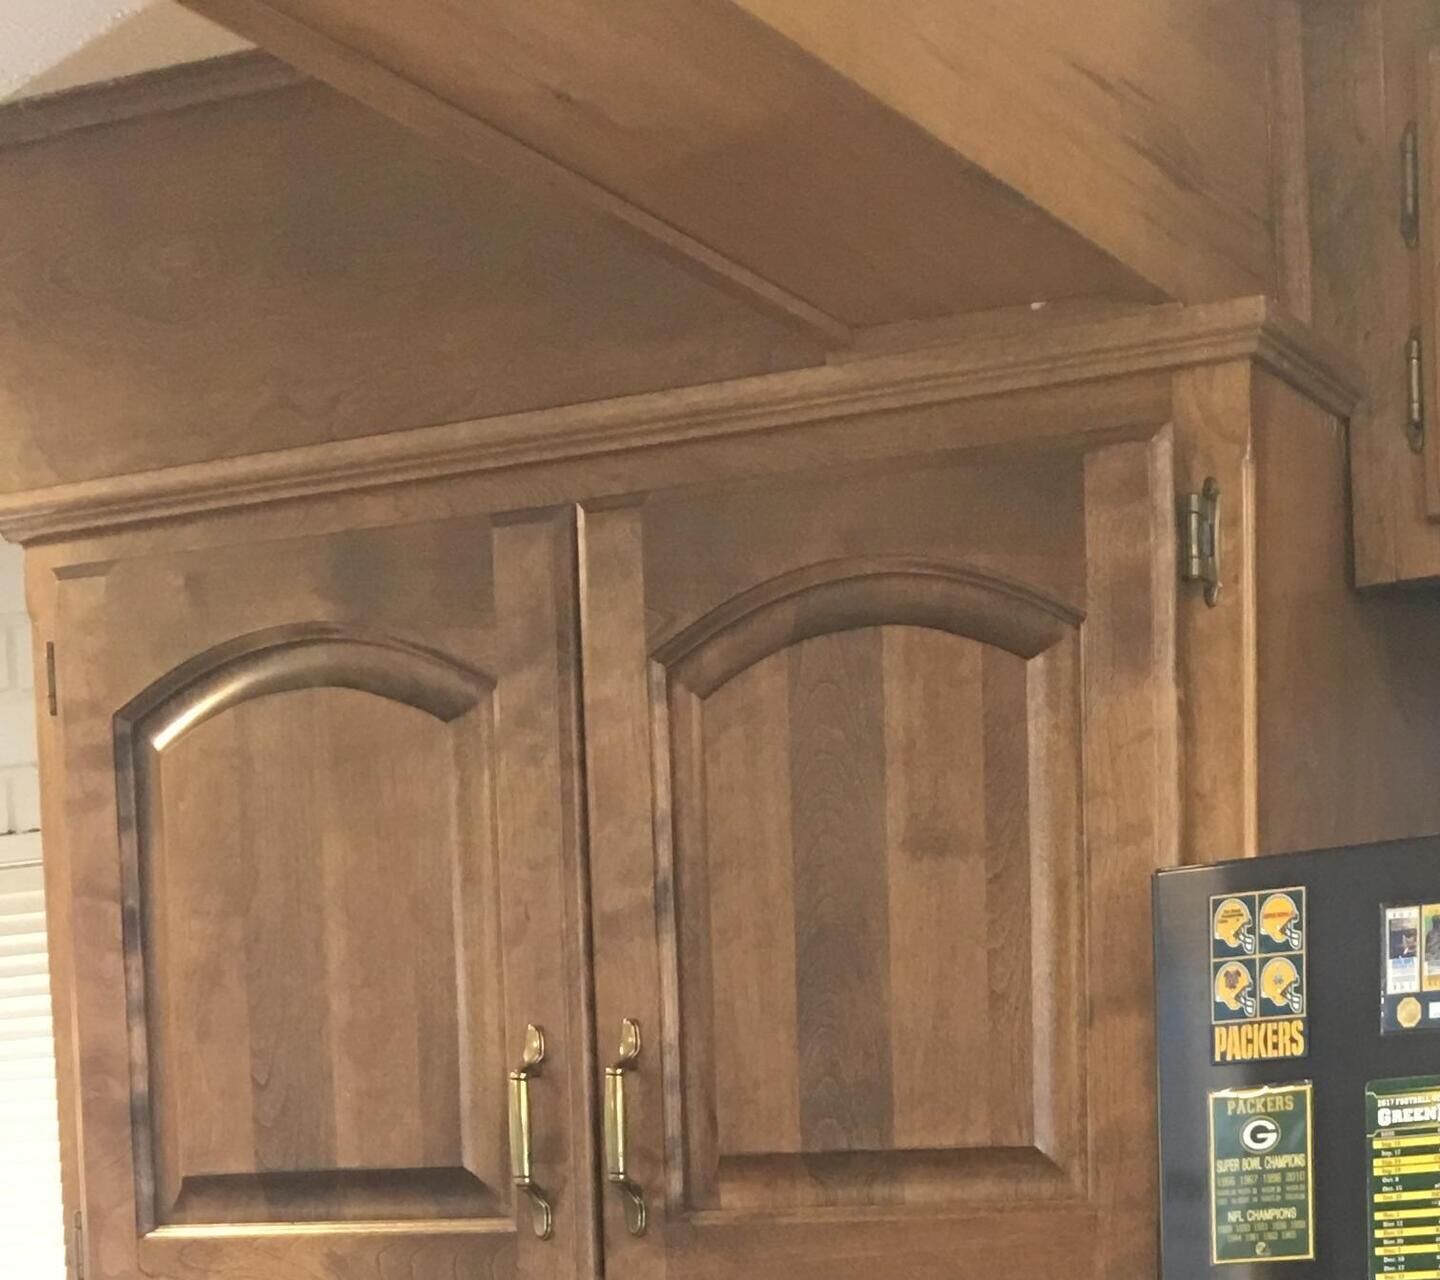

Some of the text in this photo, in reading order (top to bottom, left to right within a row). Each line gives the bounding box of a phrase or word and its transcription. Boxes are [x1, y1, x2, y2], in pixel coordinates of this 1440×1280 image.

[1214, 1020, 1304, 1062] PACKERS
[1227, 1095, 1294, 1116] PACKERS
[1396, 1095, 1431, 1106] FOOTBALL
[1216, 1153, 1306, 1173] SUPER BOWL CHAMPIONS
[1227, 1207, 1297, 1223] NFL CHAMPIONS
